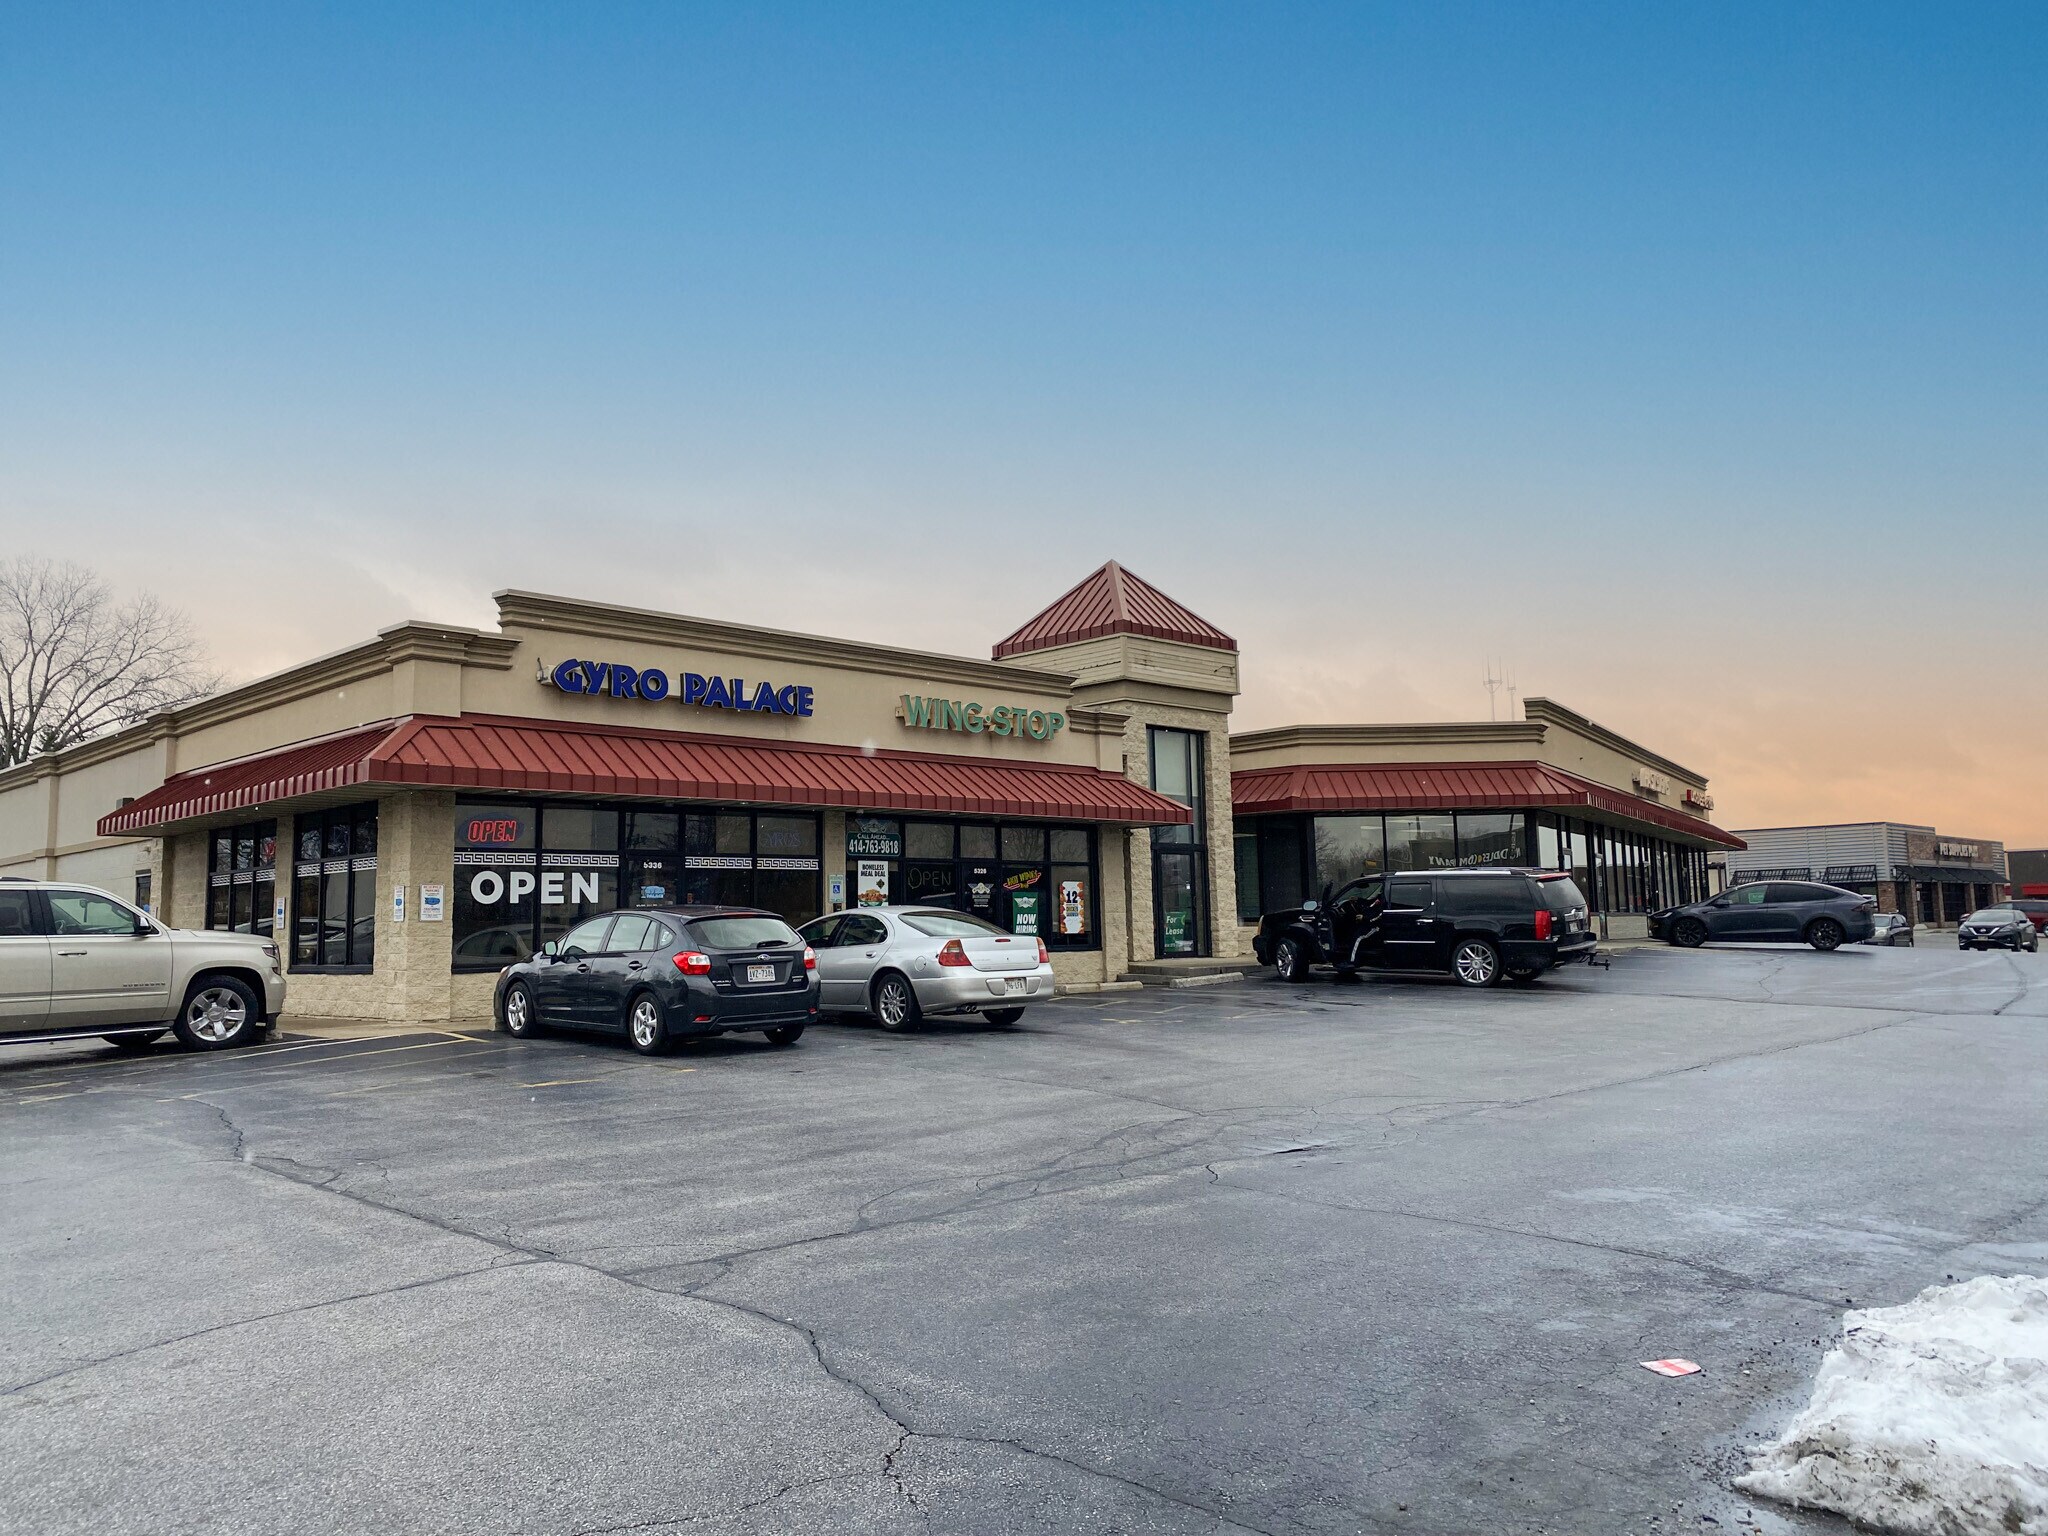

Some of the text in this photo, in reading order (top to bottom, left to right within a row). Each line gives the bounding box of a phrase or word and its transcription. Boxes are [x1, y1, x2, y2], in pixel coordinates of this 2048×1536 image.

[551, 658, 814, 717] GYRO PALACE
[468, 820, 517, 842] OPEN
[849, 839, 899, 854] 414-763-9818
[908, 867, 951, 889] OPEN
[470, 871, 599, 904] OPEN
[1066, 890, 1078, 904] 12
[1016, 913, 1037, 925] NOW
[1166, 915, 1177, 924] For
[1015, 924, 1038, 934] HIRING
[1165, 926, 1184, 935] Lease
